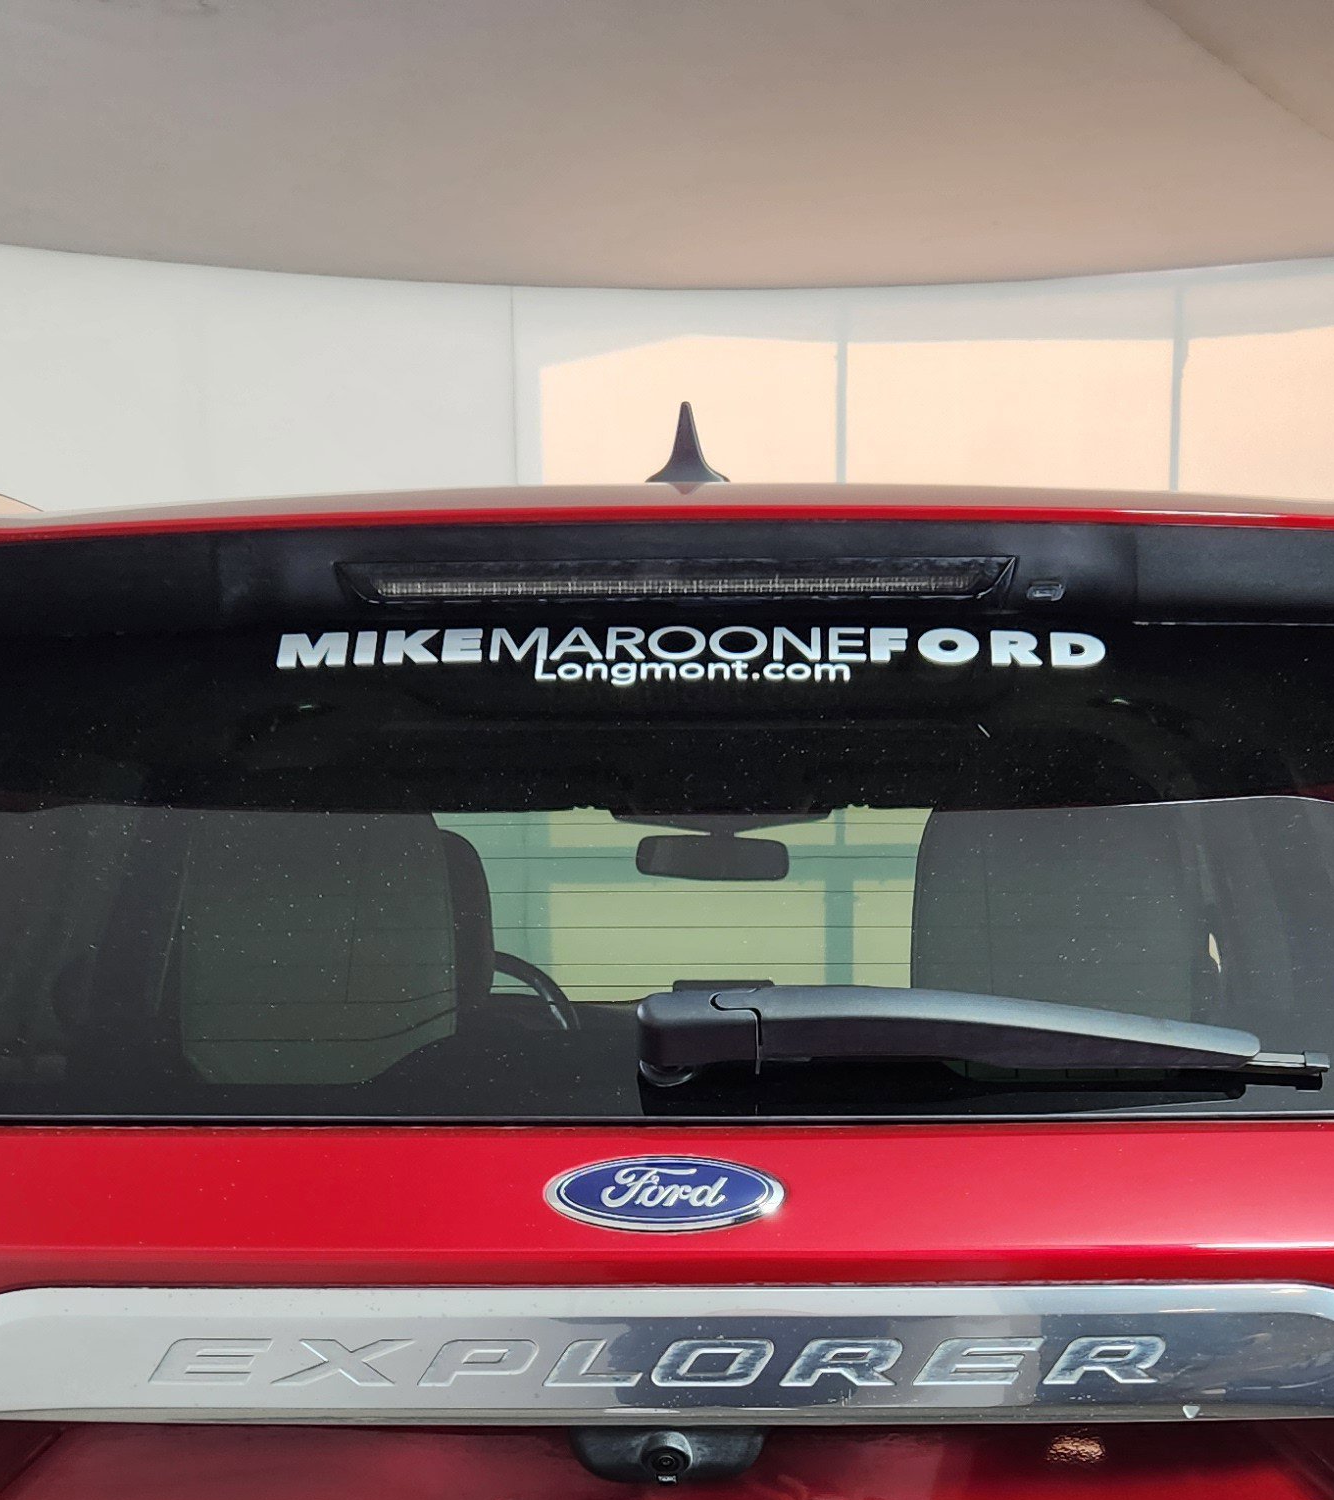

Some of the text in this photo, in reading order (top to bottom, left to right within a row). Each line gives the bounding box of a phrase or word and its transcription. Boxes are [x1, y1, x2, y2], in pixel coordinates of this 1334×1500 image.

[534, 657, 852, 685] Longmont.com
[600, 1166, 729, 1208] Ford
[148, 1336, 1167, 1387] EXPLORER
